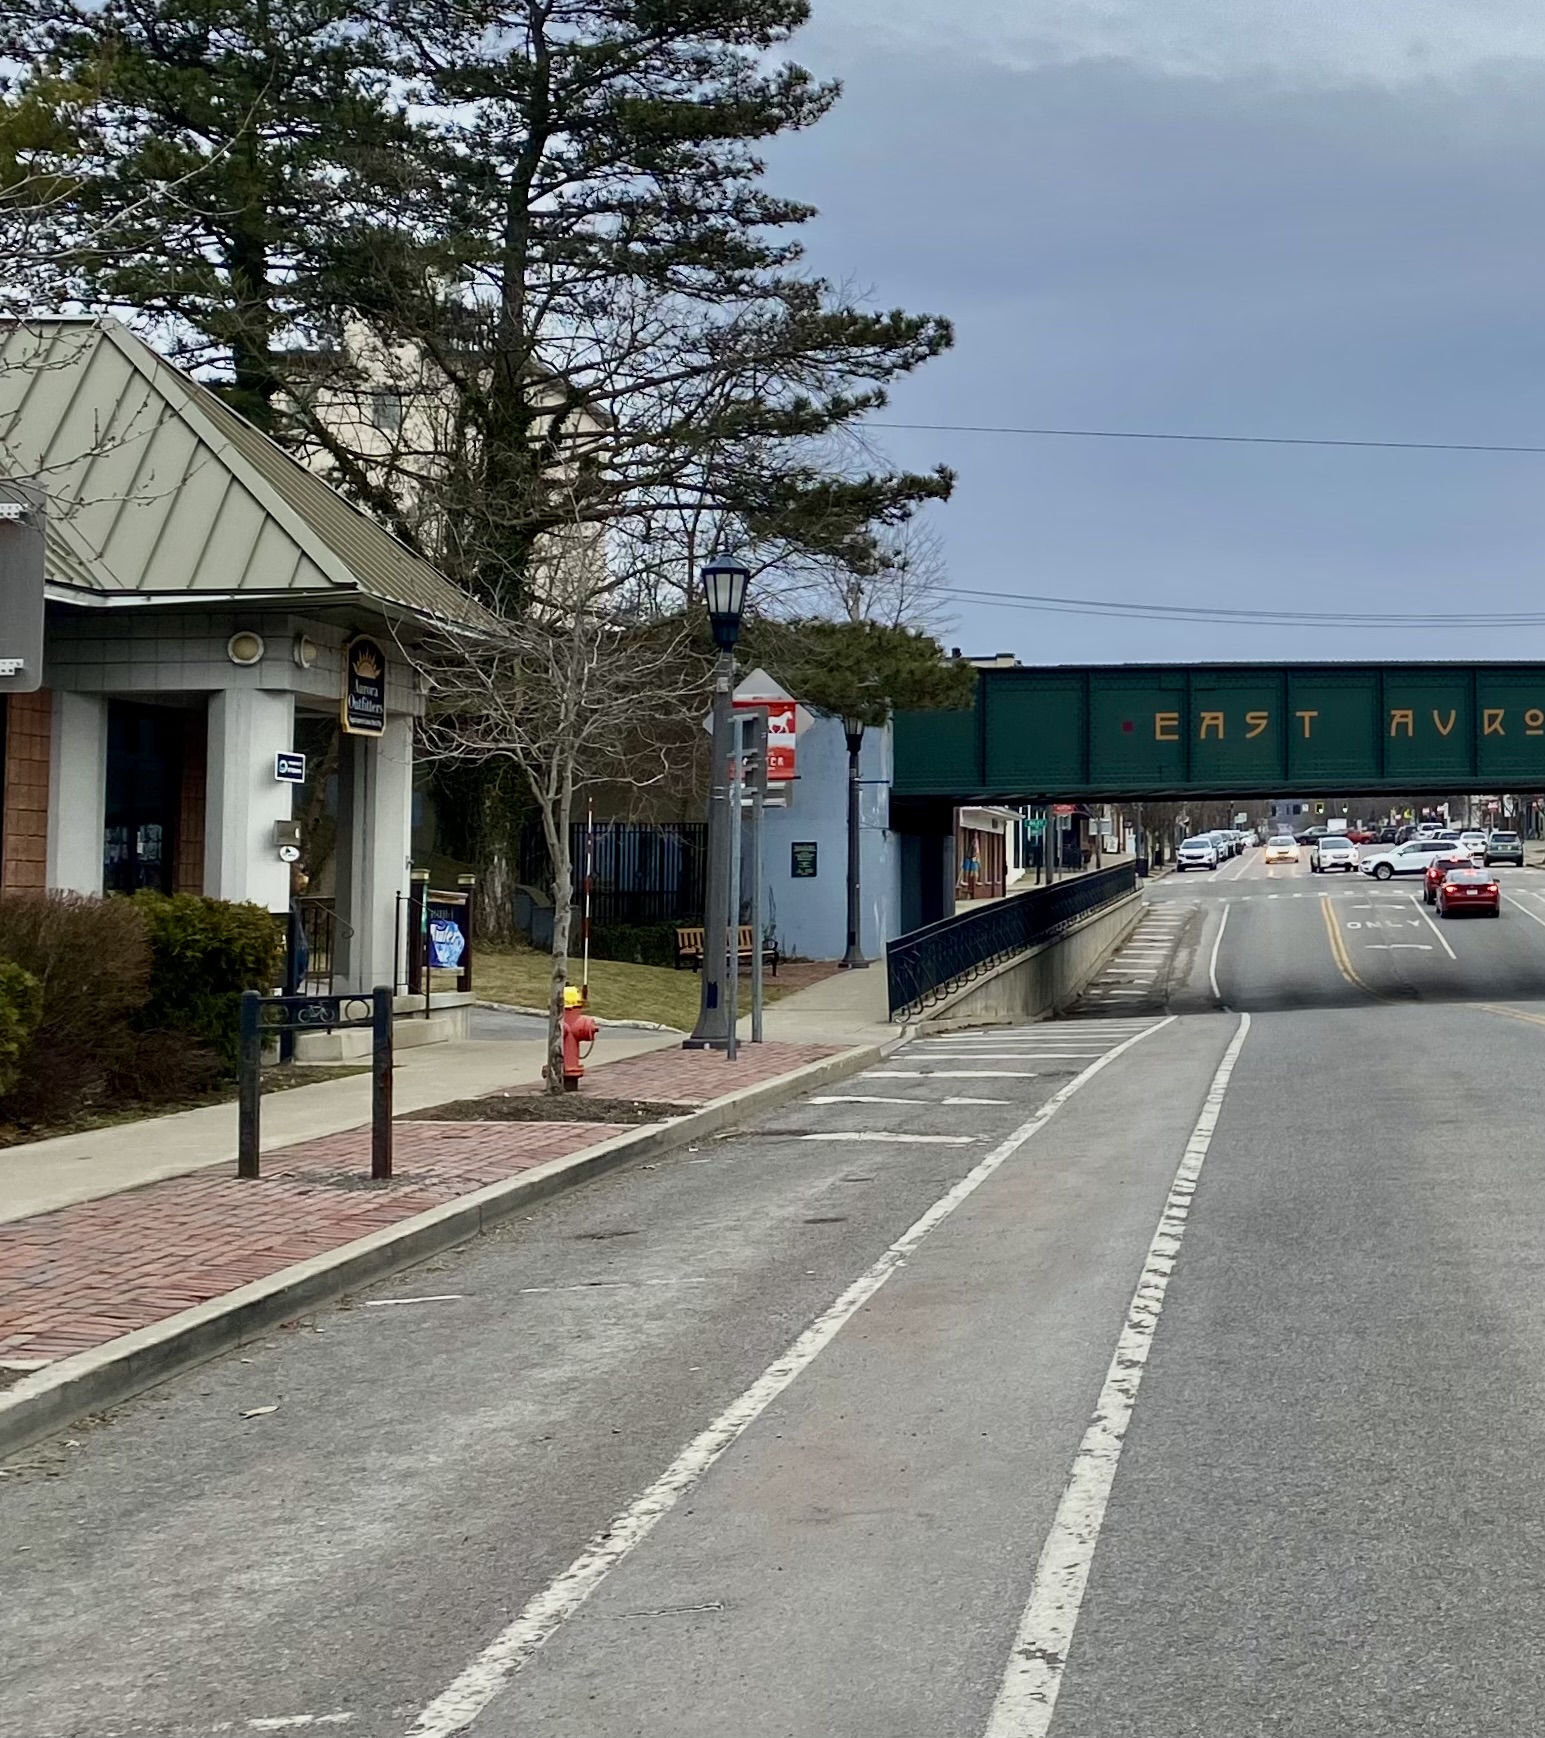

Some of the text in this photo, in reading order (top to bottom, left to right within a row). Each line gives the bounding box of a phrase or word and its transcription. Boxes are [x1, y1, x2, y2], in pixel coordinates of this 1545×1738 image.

[355, 678, 378, 698] Aurora
[348, 693, 383, 714] Outfitters
[1154, 710, 1319, 741] EAST
[1346, 919, 1421, 929] ONLY
